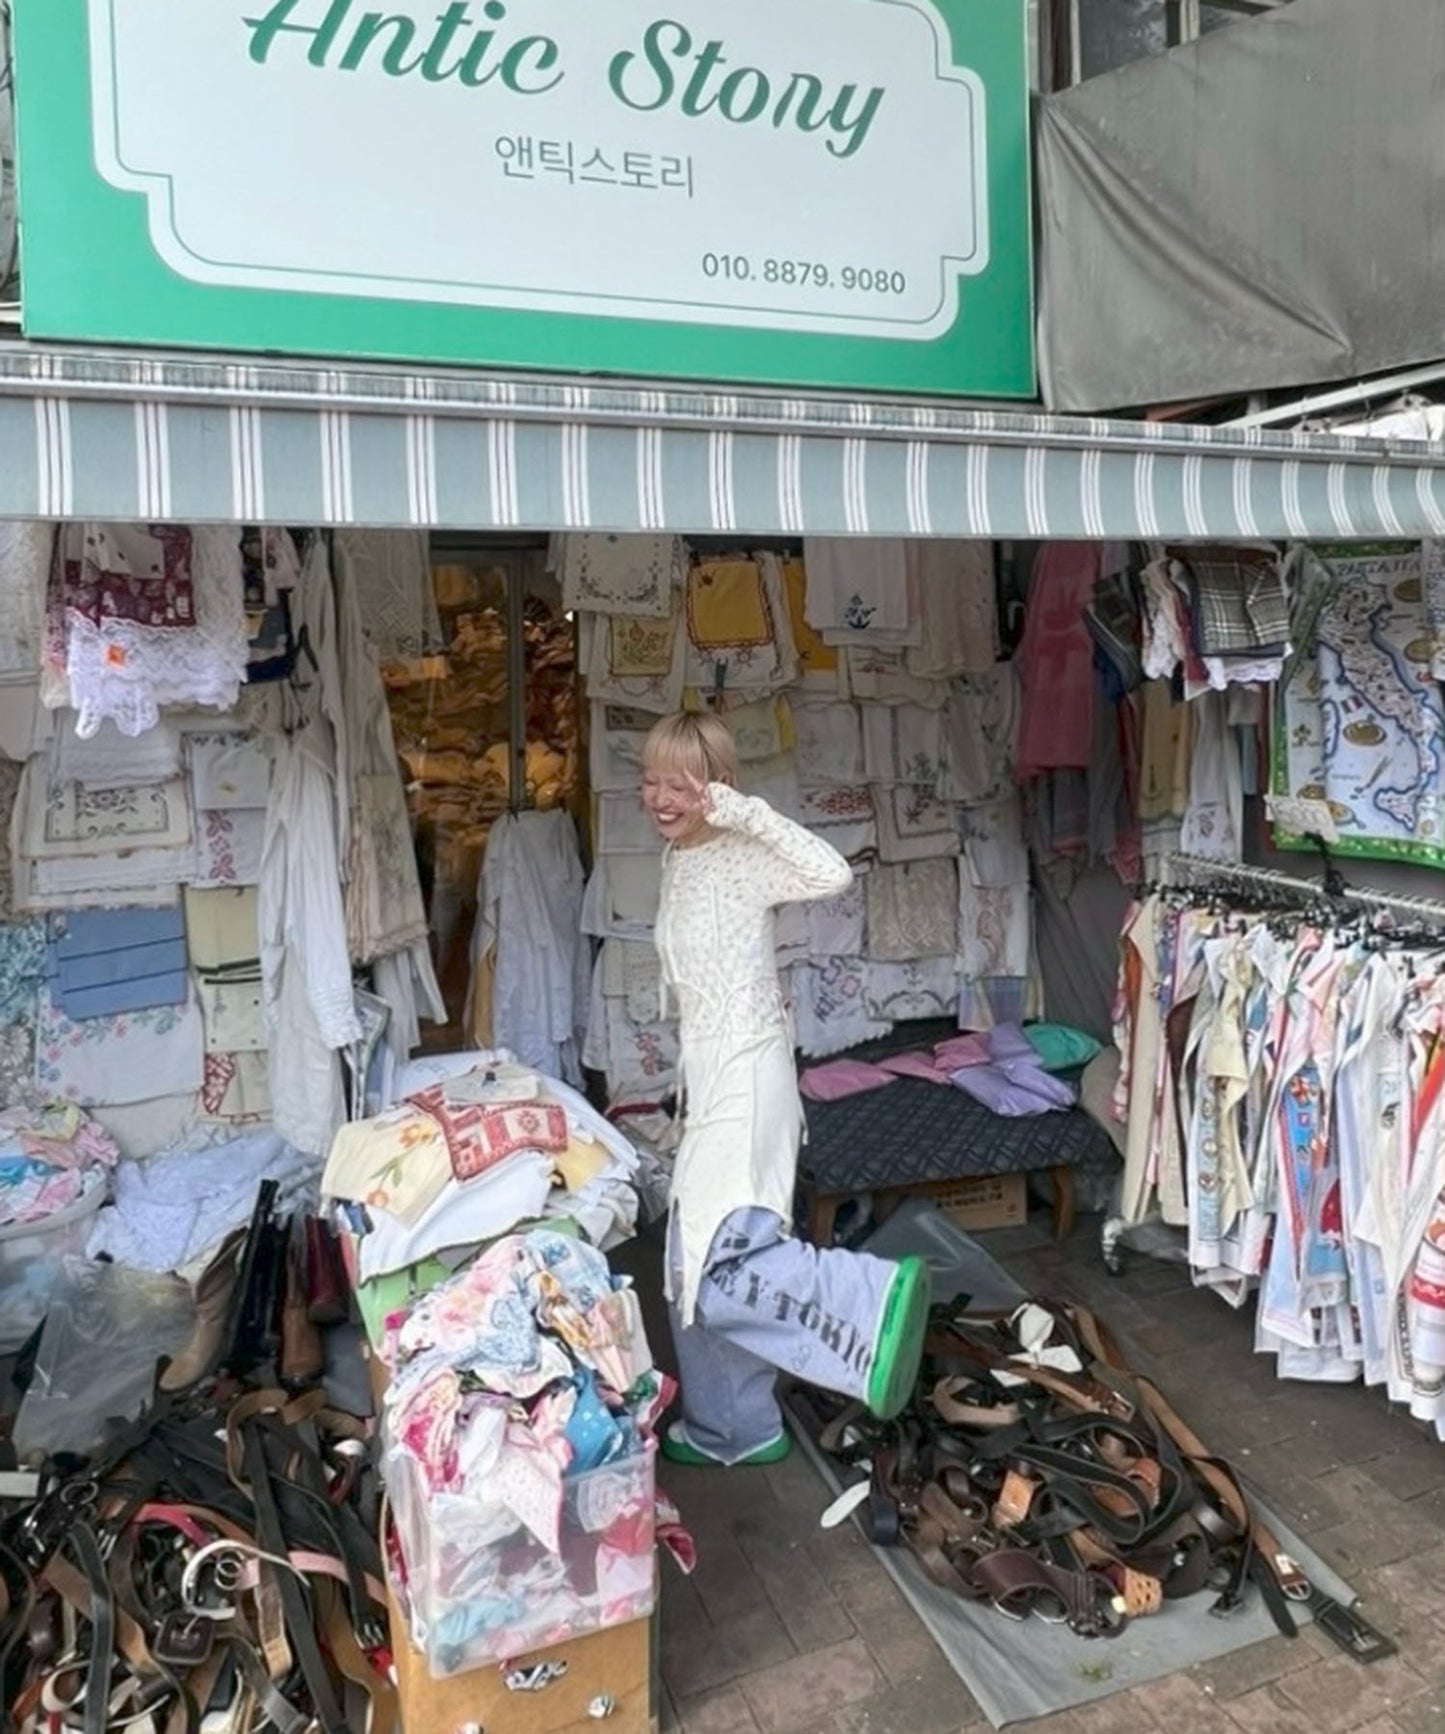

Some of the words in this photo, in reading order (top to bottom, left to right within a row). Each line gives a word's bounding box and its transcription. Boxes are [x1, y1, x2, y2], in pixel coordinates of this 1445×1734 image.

[241, 0, 566, 94] Antic
[608, 19, 886, 159] Story
[494, 134, 695, 199] 앤틱스토리
